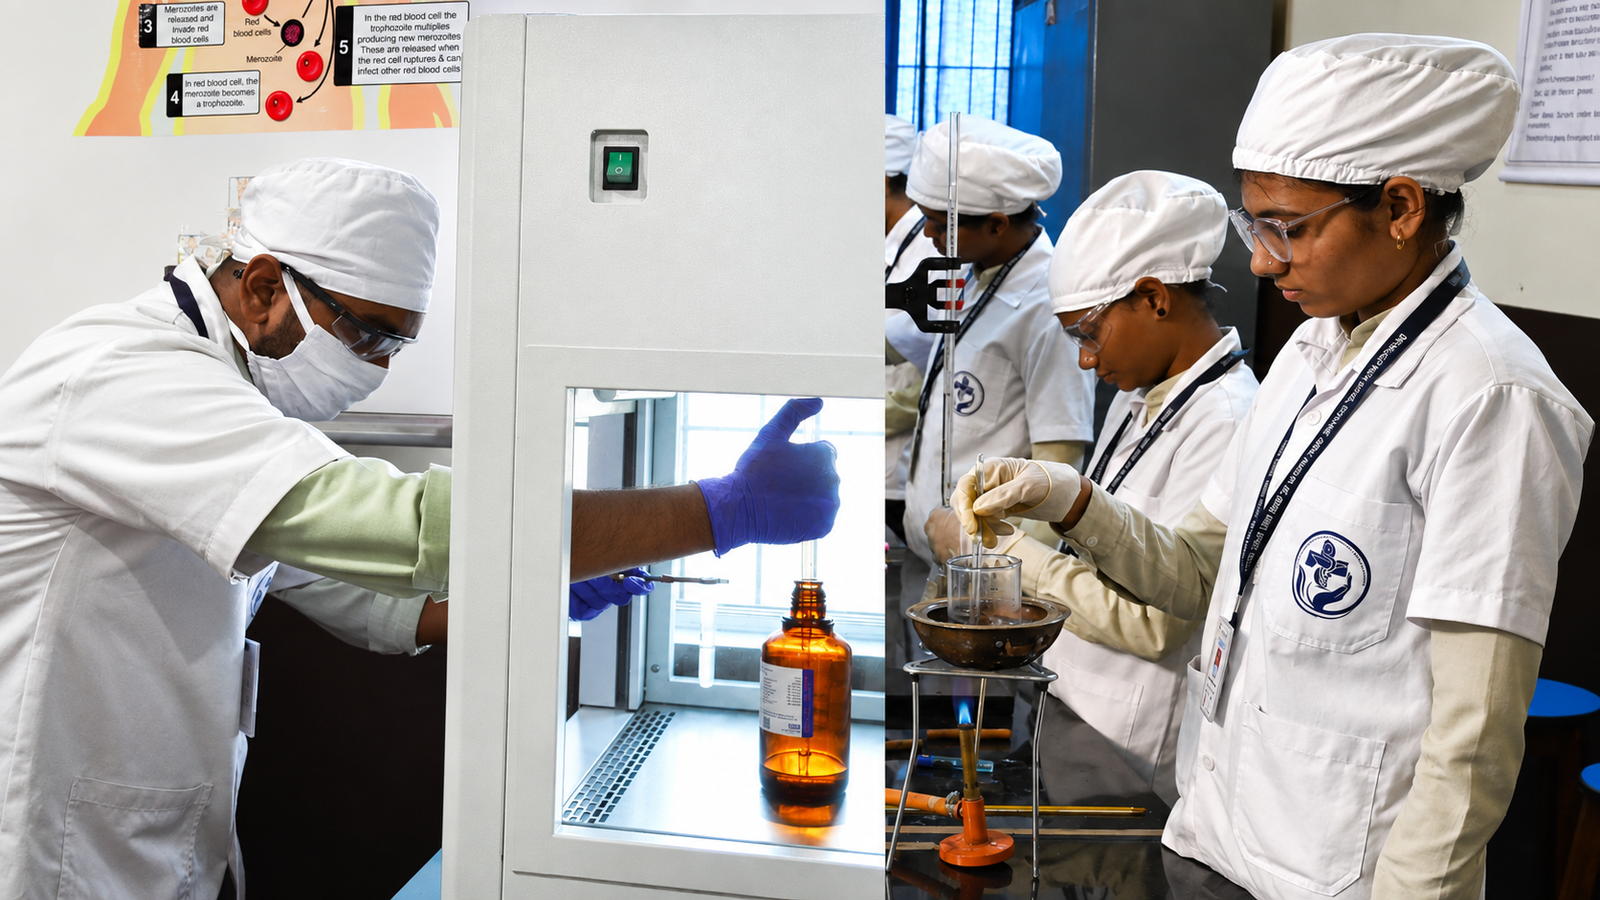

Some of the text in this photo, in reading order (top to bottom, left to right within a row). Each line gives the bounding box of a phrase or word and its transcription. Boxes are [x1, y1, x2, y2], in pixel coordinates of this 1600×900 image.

[164, 5, 204, 13] Merozoites
[168, 15, 199, 23] released
[144, 19, 152, 33] 3
[370, 23, 450, 33] trophozoite multiplies
[233, 28, 271, 37] blood cells
[358, 35, 396, 44] producing
[417, 33, 461, 41] merozoites
[339, 40, 348, 54] 5
[246, 55, 283, 63] Merozoite
[373, 56, 386, 64] red
[403, 55, 436, 64] ruptures
[443, 65, 461, 73] cells
[170, 90, 179, 104] 4
